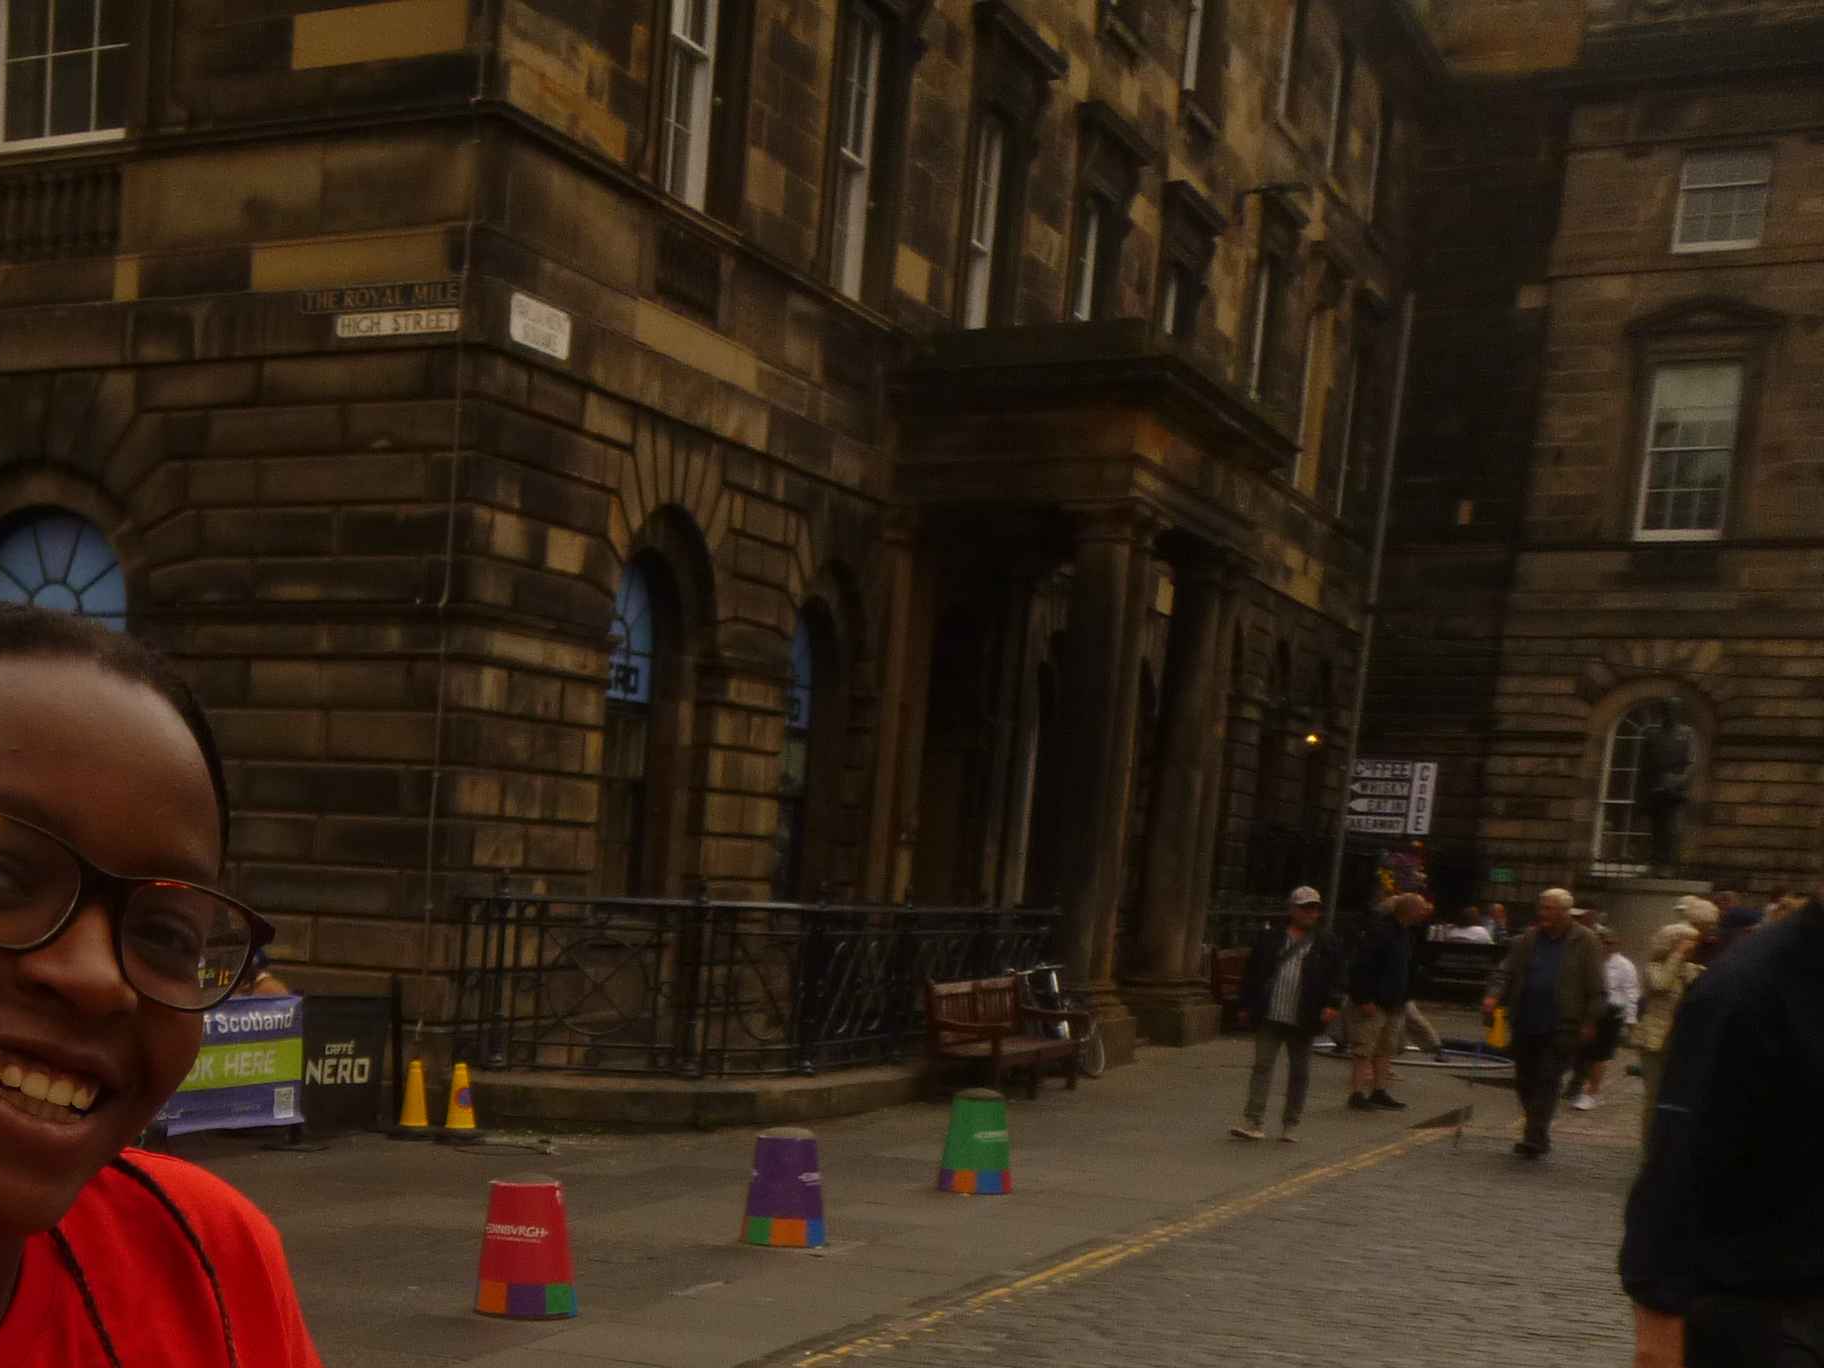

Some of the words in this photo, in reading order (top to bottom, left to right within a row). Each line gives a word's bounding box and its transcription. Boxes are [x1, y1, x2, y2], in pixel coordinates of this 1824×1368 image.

[304, 290, 335, 312] THE
[343, 286, 403, 308] ROYAL
[414, 281, 459, 303] MILE
[340, 316, 381, 334] HIGH
[393, 311, 457, 332] STREET
[217, 1008, 295, 1034] Scotland
[224, 1050, 277, 1078] HERE
[305, 1056, 371, 1085] NERO
